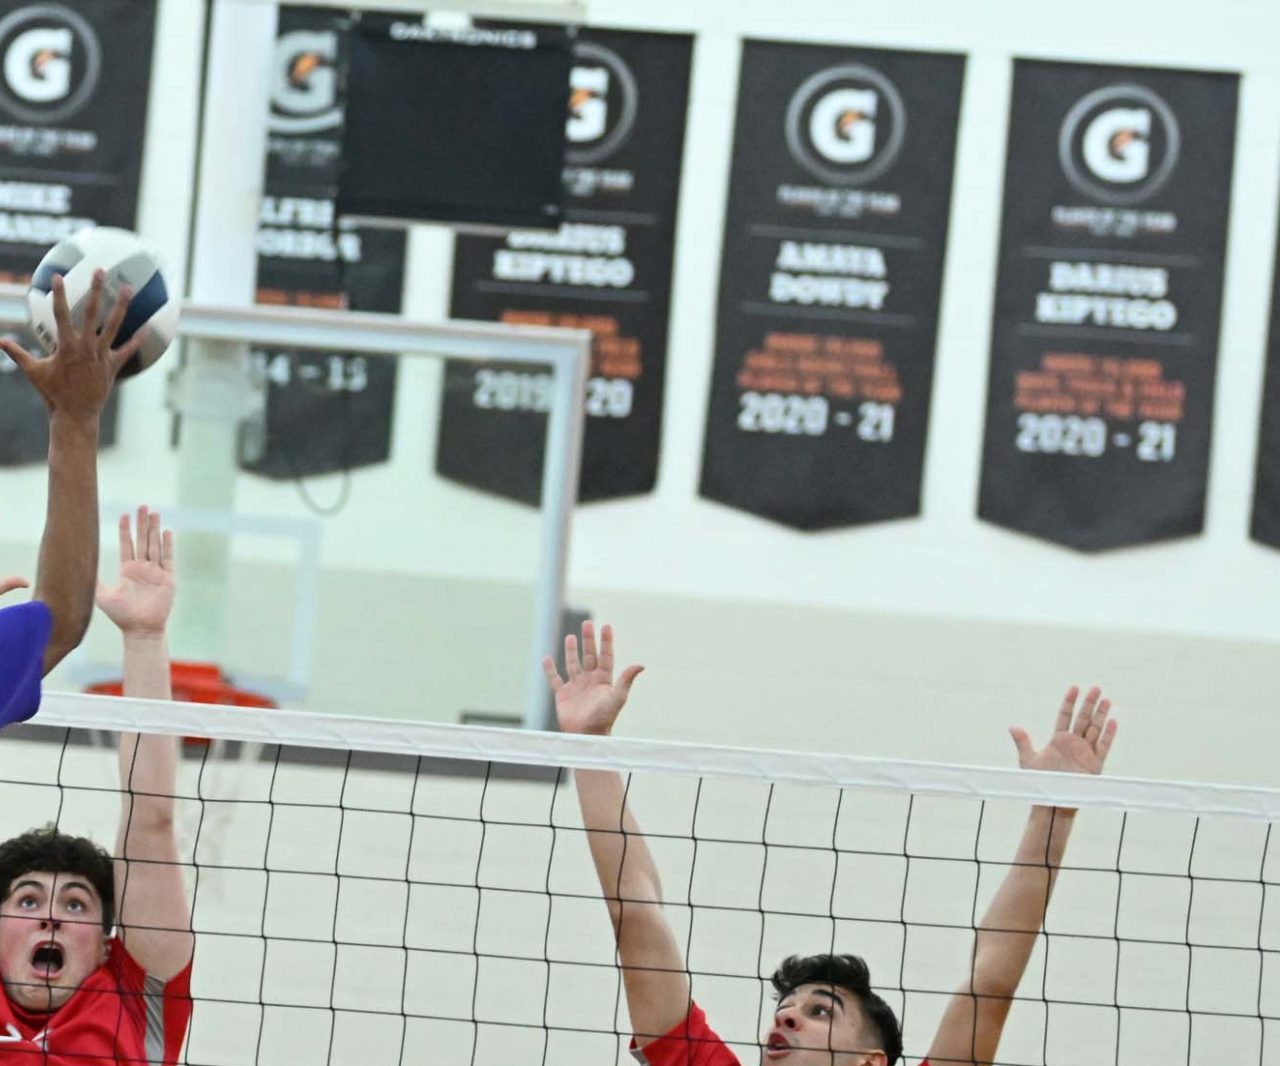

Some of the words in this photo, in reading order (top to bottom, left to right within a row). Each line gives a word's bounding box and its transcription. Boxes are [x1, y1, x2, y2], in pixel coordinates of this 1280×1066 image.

[4, 28, 72, 101] G
[810, 89, 877, 163] G
[1083, 109, 1151, 182] G
[737, 391, 829, 436] 2020
[857, 401, 895, 442] 21
[1015, 412, 1107, 457] 2020
[1137, 420, 1176, 461] 21
